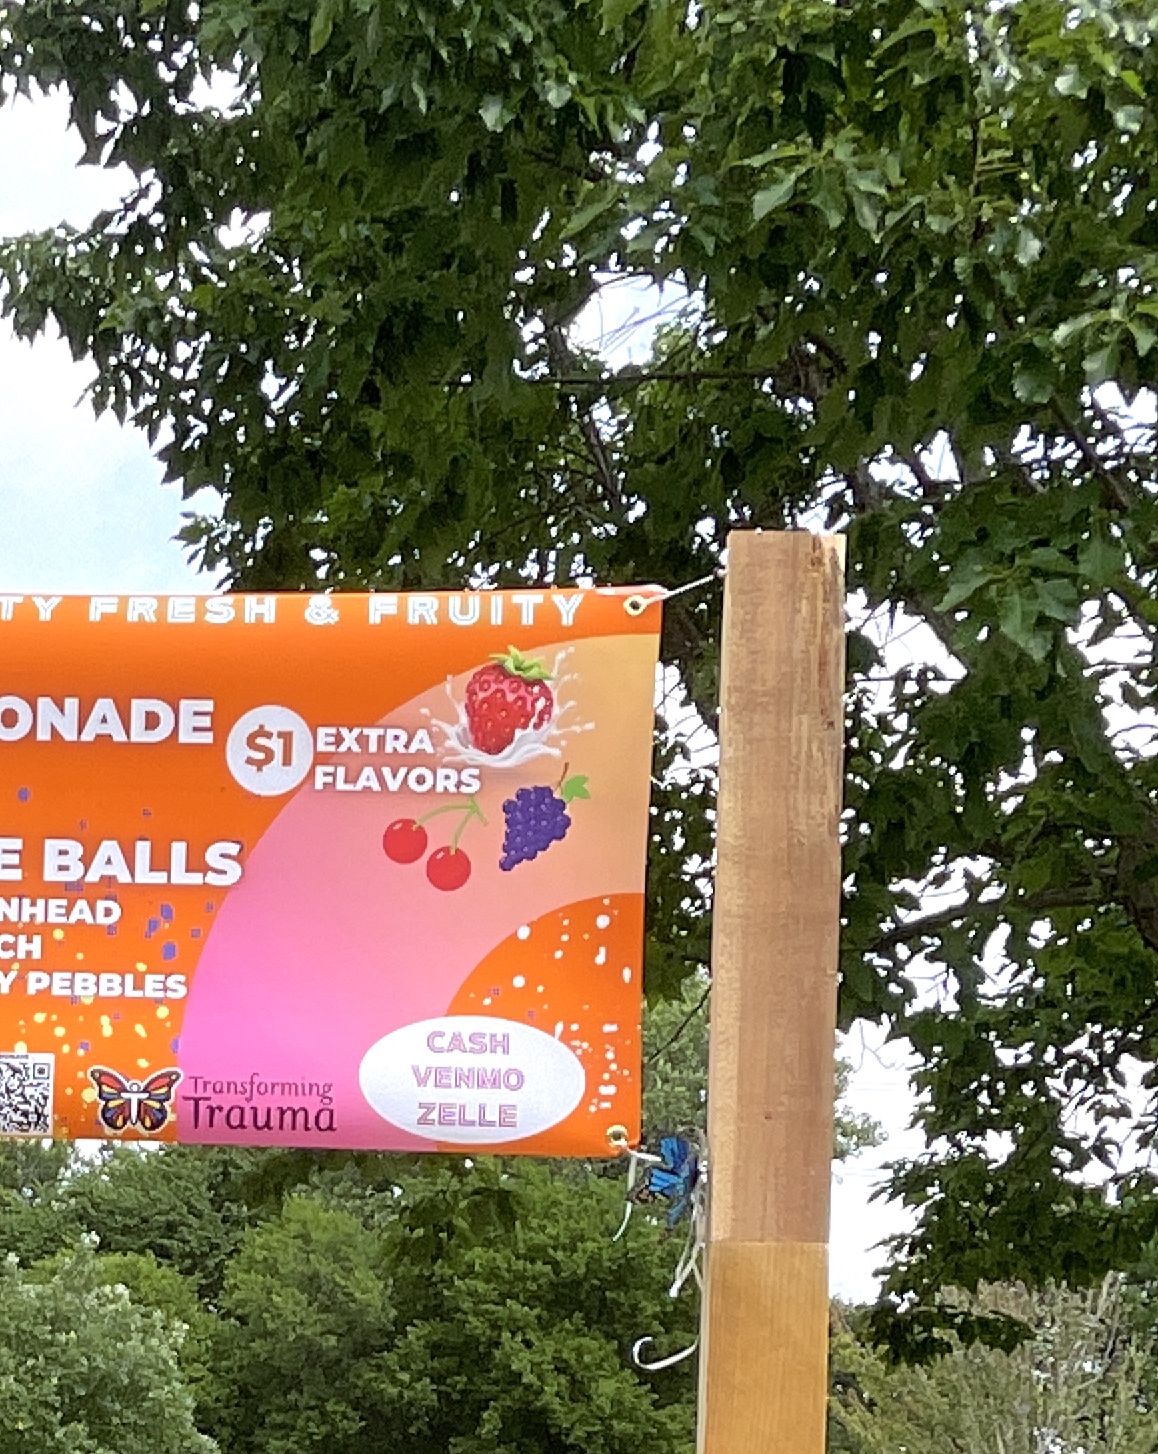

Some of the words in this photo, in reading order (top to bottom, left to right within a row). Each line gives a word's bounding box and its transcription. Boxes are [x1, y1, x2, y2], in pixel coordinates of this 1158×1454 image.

[88, 594, 277, 625] FRESH
[304, 596, 340, 626] &
[368, 593, 585, 626] FRUITY
[244, 724, 295, 772] $1
[315, 727, 434, 755] EXTRA
[314, 766, 481, 795] FLAVORS
[43, 838, 243, 887] BALLS
[28, 970, 188, 999] PEBBLES
[426, 1029, 510, 1055] CASH
[188, 1072, 333, 1106] Transforming
[411, 1064, 525, 1091] VENMO
[182, 1096, 338, 1132] Trauma
[417, 1101, 518, 1128] ZELLE
